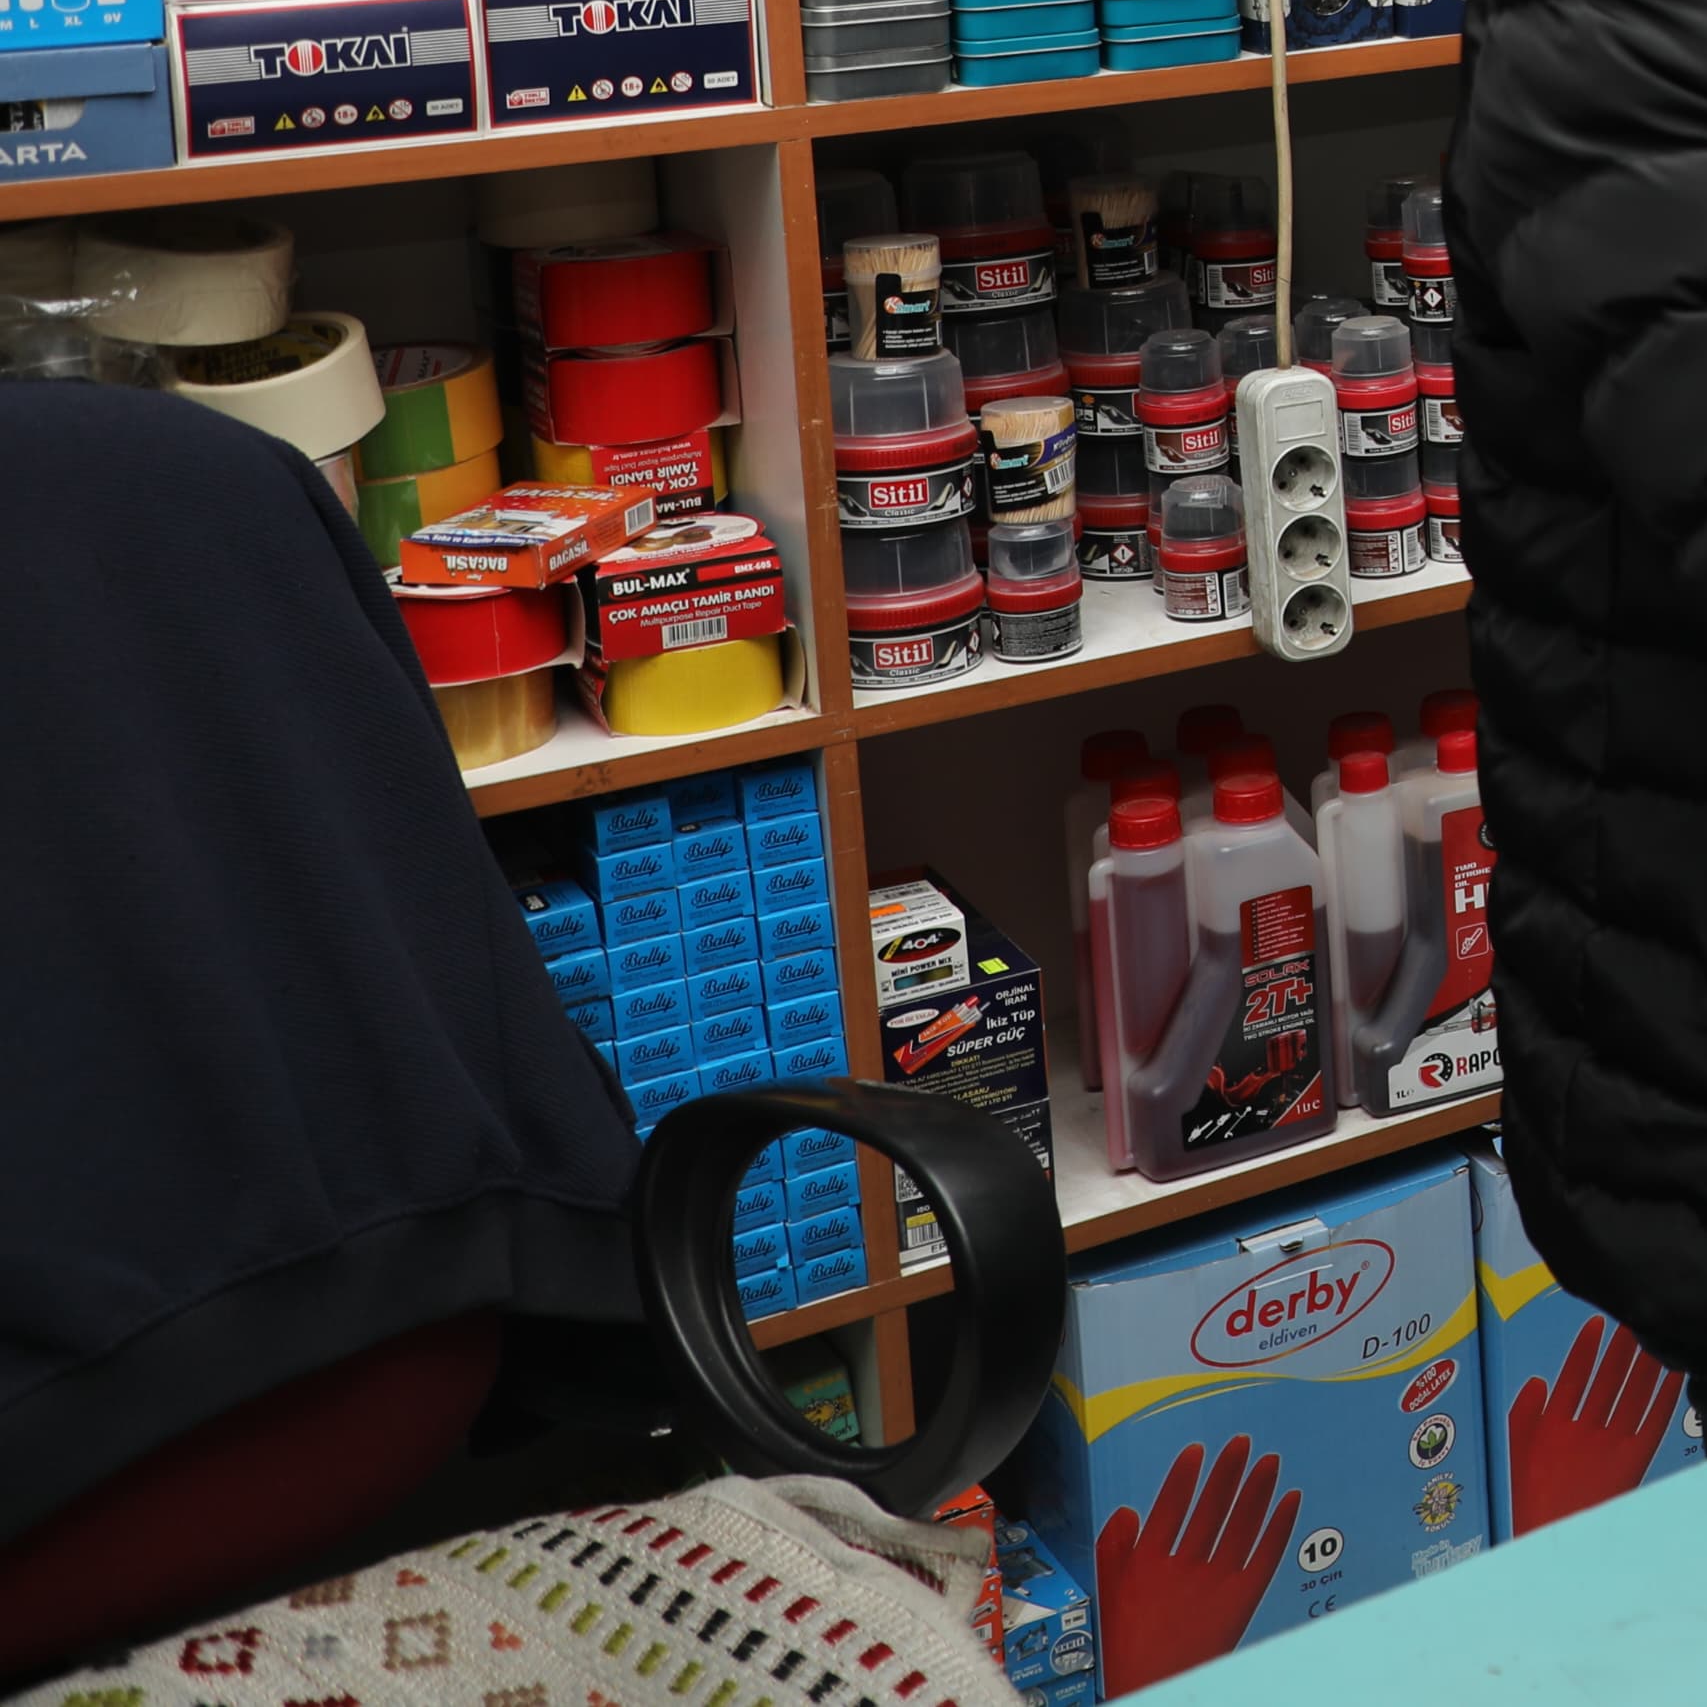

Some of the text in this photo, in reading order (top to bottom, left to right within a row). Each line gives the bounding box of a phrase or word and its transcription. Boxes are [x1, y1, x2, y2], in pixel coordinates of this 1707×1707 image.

[251, 31, 412, 79] TOKAI
[0, 141, 88, 166] ARTA
[979, 267, 1027, 288] Sitil
[1183, 429, 1220, 450] Sitil
[873, 482, 927, 508] Sitil
[612, 571, 688, 596] BUL-MAX
[608, 584, 775, 625] ÇOK AMAÇLI TAMİR BANDI
[640, 611, 695, 628] Multipurpose
[877, 642, 933, 667] Sitil
[608, 808, 655, 833] Bally
[766, 869, 816, 894] Bally
[910, 960, 937, 974] POWER
[625, 990, 678, 1016] Bally
[1243, 977, 1314, 1027] 2T+
[986, 1009, 1036, 1030] İkiz Tüp
[947, 1026, 1027, 1058] SÜPER GÜÇ
[807, 1256, 855, 1282] Bally
[1225, 1269, 1361, 1340] derby
[1258, 1323, 1318, 1352] eldiven
[1362, 1313, 1432, 1361] D-100
[1304, 1537, 1338, 1564] 10
